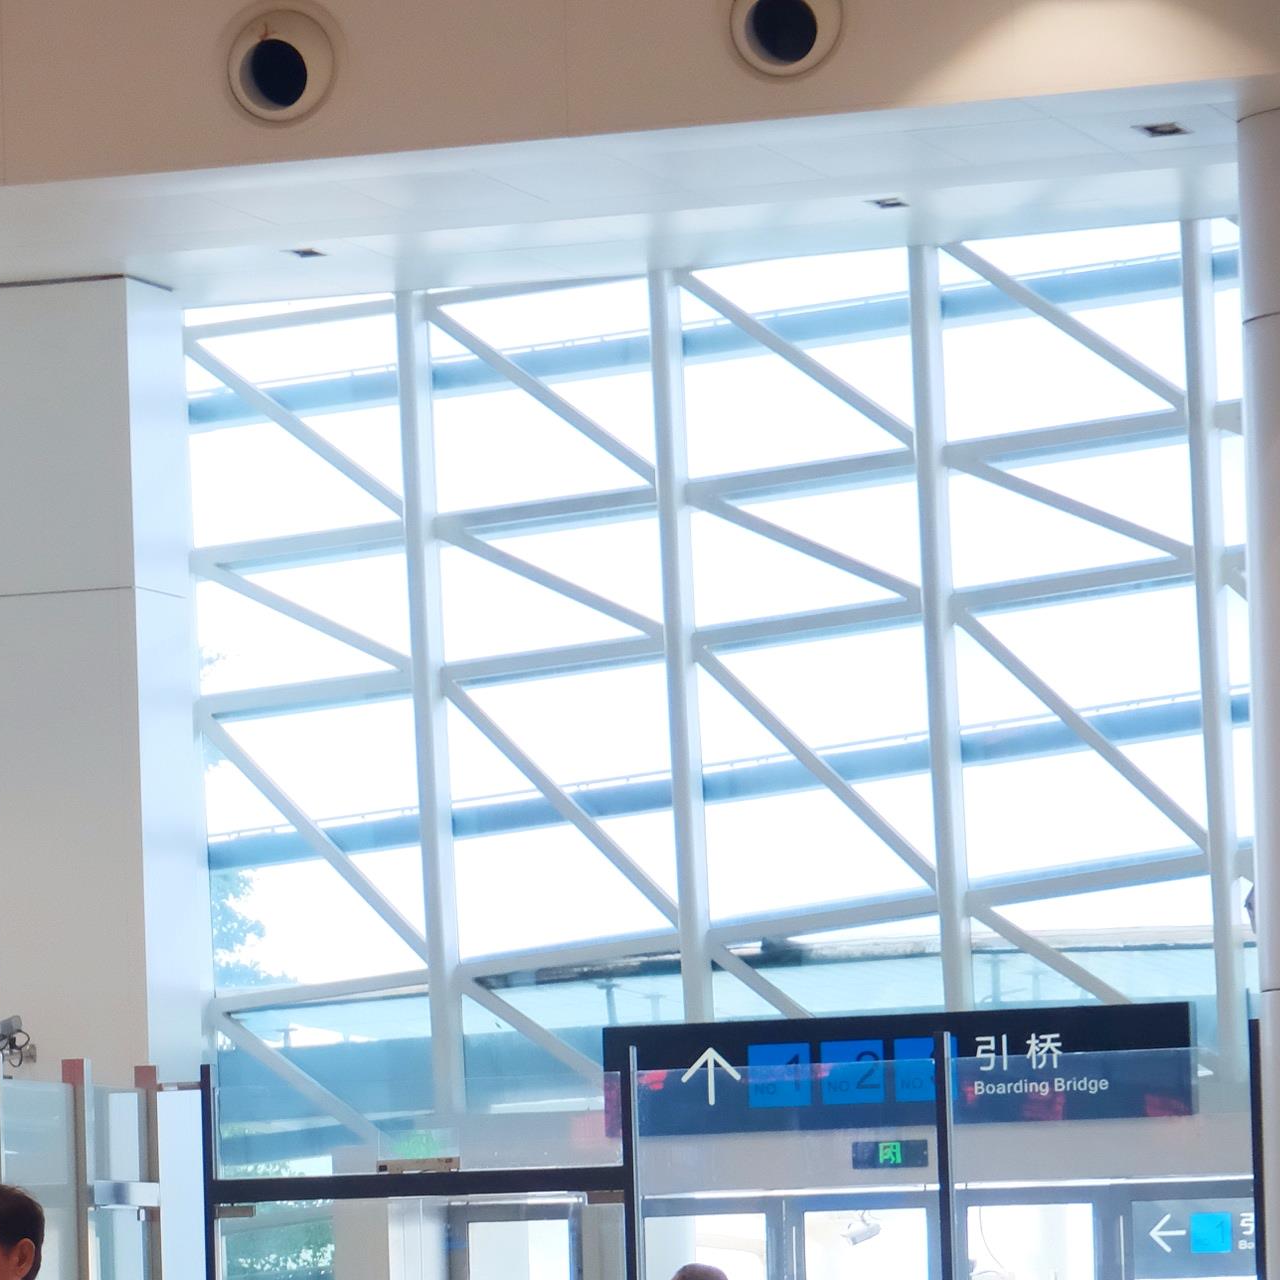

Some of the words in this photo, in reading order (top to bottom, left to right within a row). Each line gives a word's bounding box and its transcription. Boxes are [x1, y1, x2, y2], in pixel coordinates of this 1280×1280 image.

[856, 1051, 880, 1089] 2
[975, 1033, 1062, 1071] 引桥
[974, 1079, 1049, 1096] Boarding
[1054, 1077, 1109, 1094] Bridge
